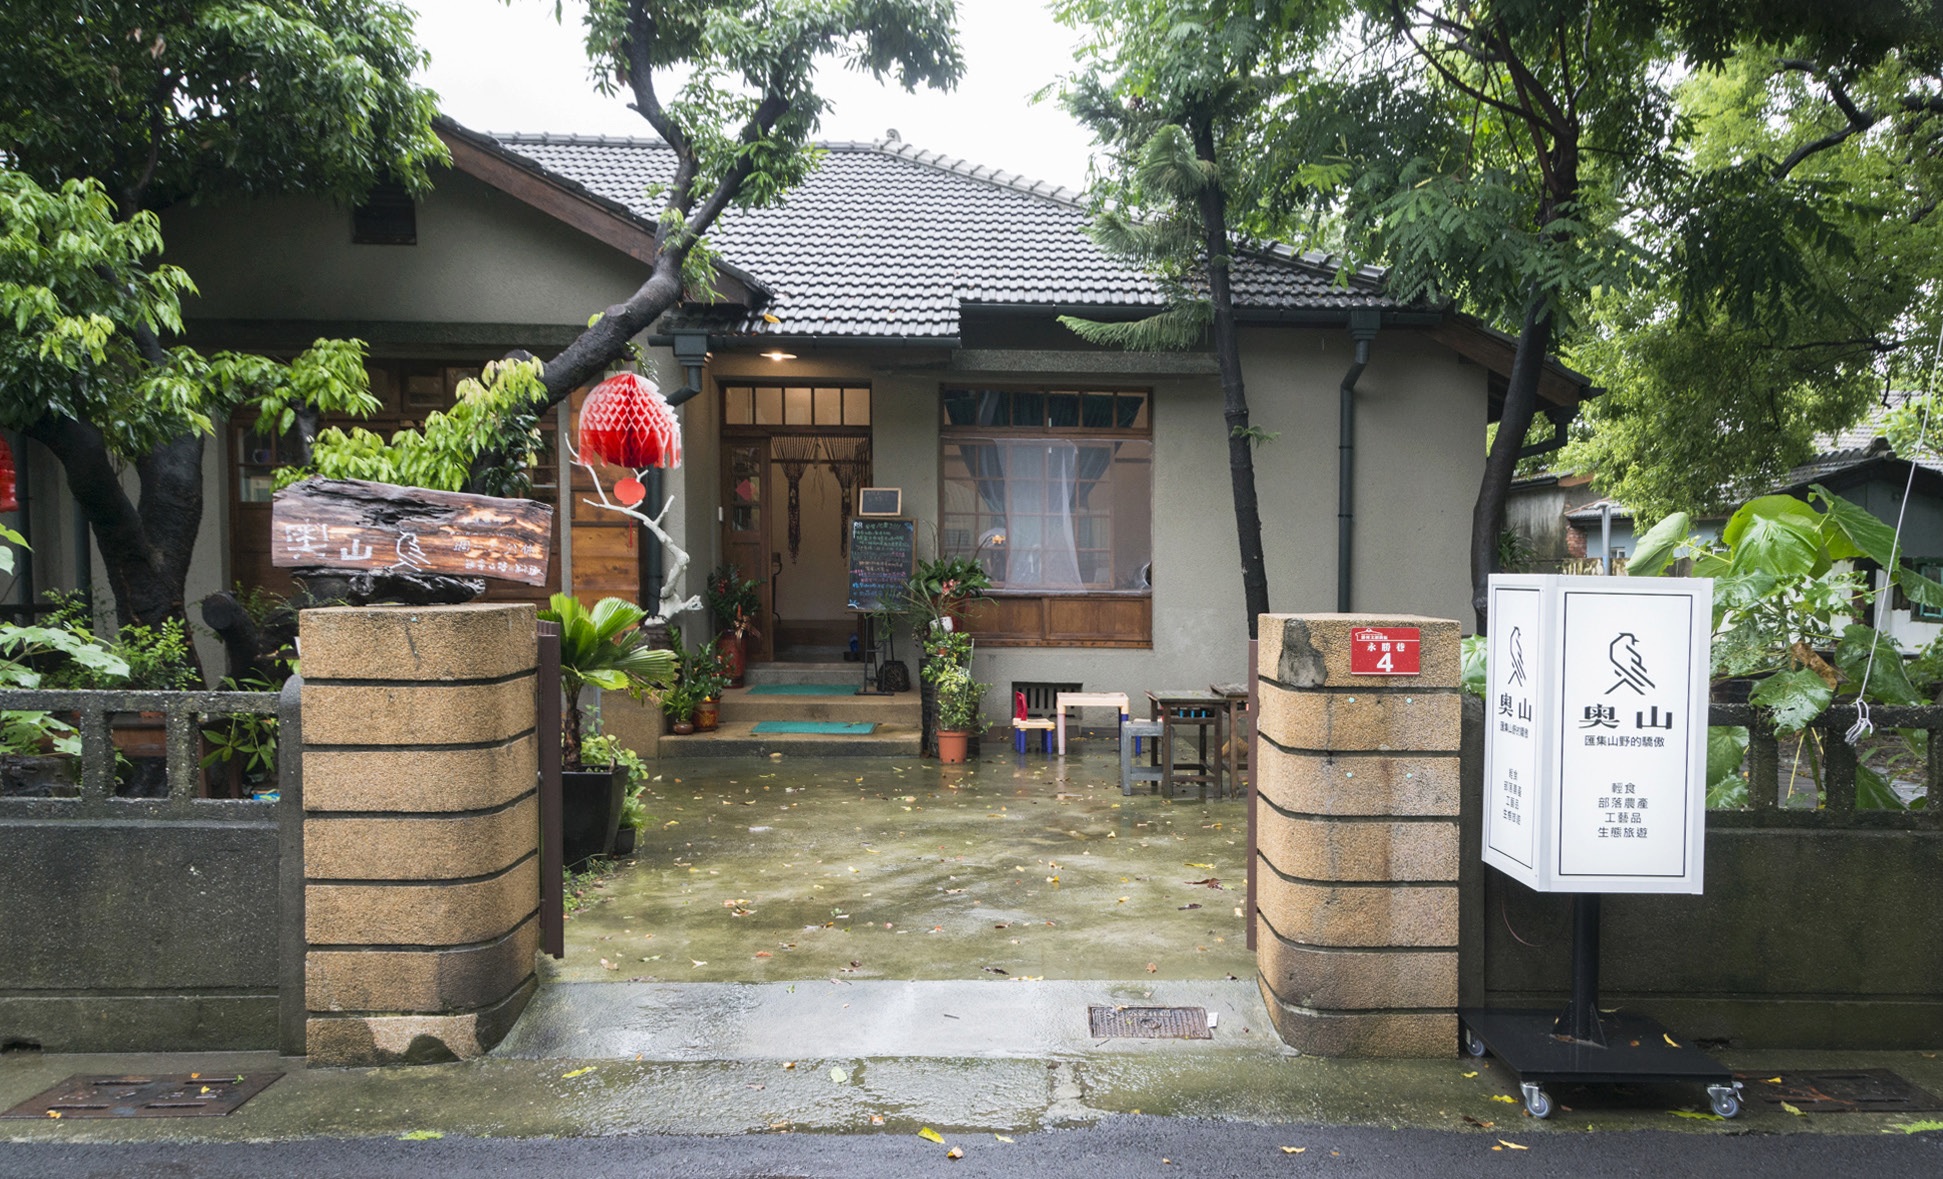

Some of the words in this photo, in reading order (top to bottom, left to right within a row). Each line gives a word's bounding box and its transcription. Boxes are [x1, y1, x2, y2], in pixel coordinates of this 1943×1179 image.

[1367, 642, 1405, 652] 永勝巷
[1376, 652, 1394, 673] 4
[1584, 734, 1665, 748] 匯集山野的驕傲
[1611, 782, 1636, 795] 輕食
[1598, 796, 1649, 810] 部落農產
[1604, 811, 1642, 824] 工藝品
[1597, 826, 1648, 839] 生態旅遊
